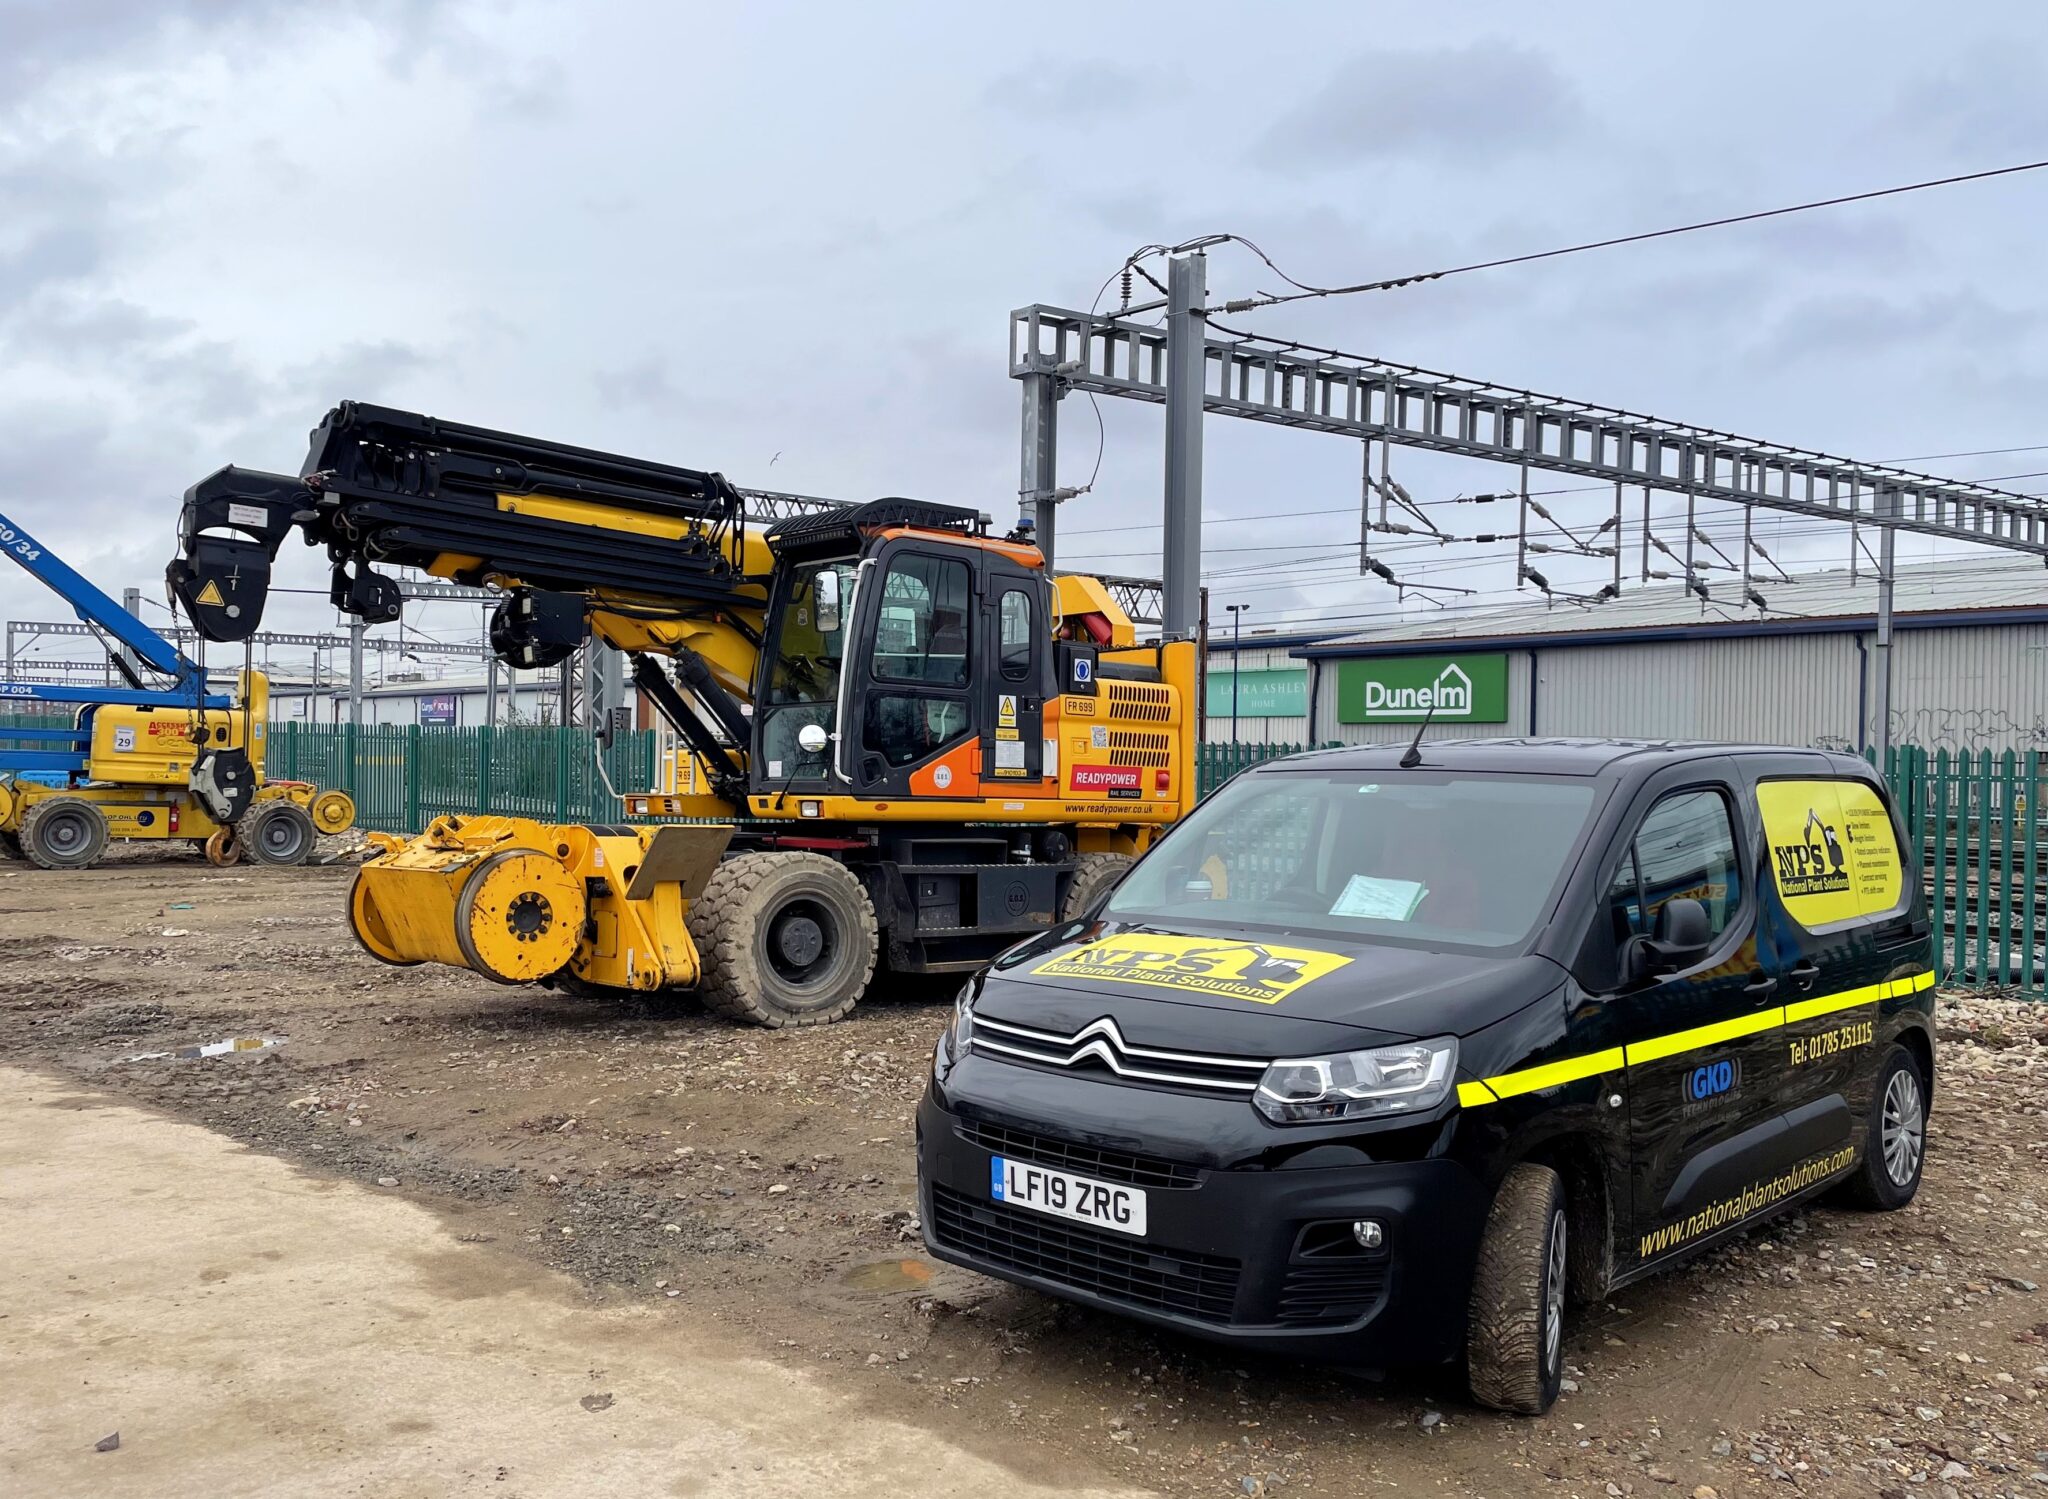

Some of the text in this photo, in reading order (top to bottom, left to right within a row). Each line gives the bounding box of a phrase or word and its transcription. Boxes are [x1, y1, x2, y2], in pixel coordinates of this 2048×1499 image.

[11, 686, 32, 694] 004
[1262, 682, 1307, 694] ASHLEY
[1366, 678, 1465, 708] Dunelm
[1068, 700, 1093, 712] FR 699
[1251, 700, 1275, 708] HOME
[159, 728, 179, 736] 300
[118, 738, 131, 747] 29
[1075, 772, 1137, 785] READYPOWER
[1065, 802, 1153, 815] www.readypower.co.uk
[1775, 843, 1825, 877] NPS
[1782, 875, 1849, 894] National Plant Solutions
[1059, 948, 1226, 973] NPS
[1045, 963, 1276, 998] National Plant Solutions
[1790, 1021, 1872, 1065] Tel: 01785 251115
[1693, 1061, 1732, 1098] GKD
[1010, 1166, 1131, 1224] LF19 ZRG
[1641, 1146, 1854, 1257] www.nationalplantsolutions.com
